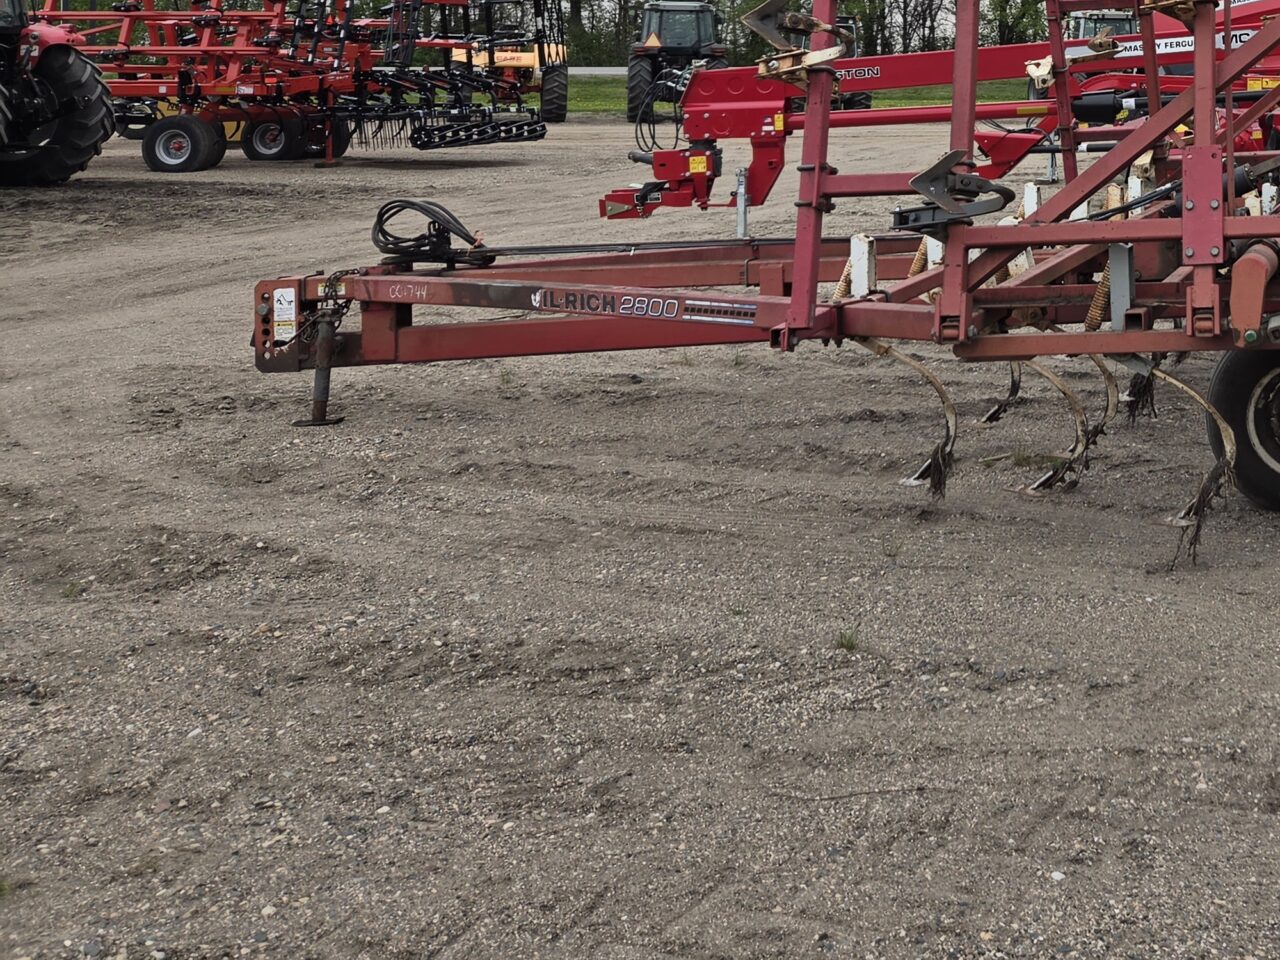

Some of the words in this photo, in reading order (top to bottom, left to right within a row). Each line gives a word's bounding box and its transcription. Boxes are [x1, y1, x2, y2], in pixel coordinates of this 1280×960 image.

[1124, 43, 1161, 52] MASY
[1164, 40, 1194, 49] FERGU
[835, 66, 880, 80] STON
[619, 296, 679, 318] 2800
